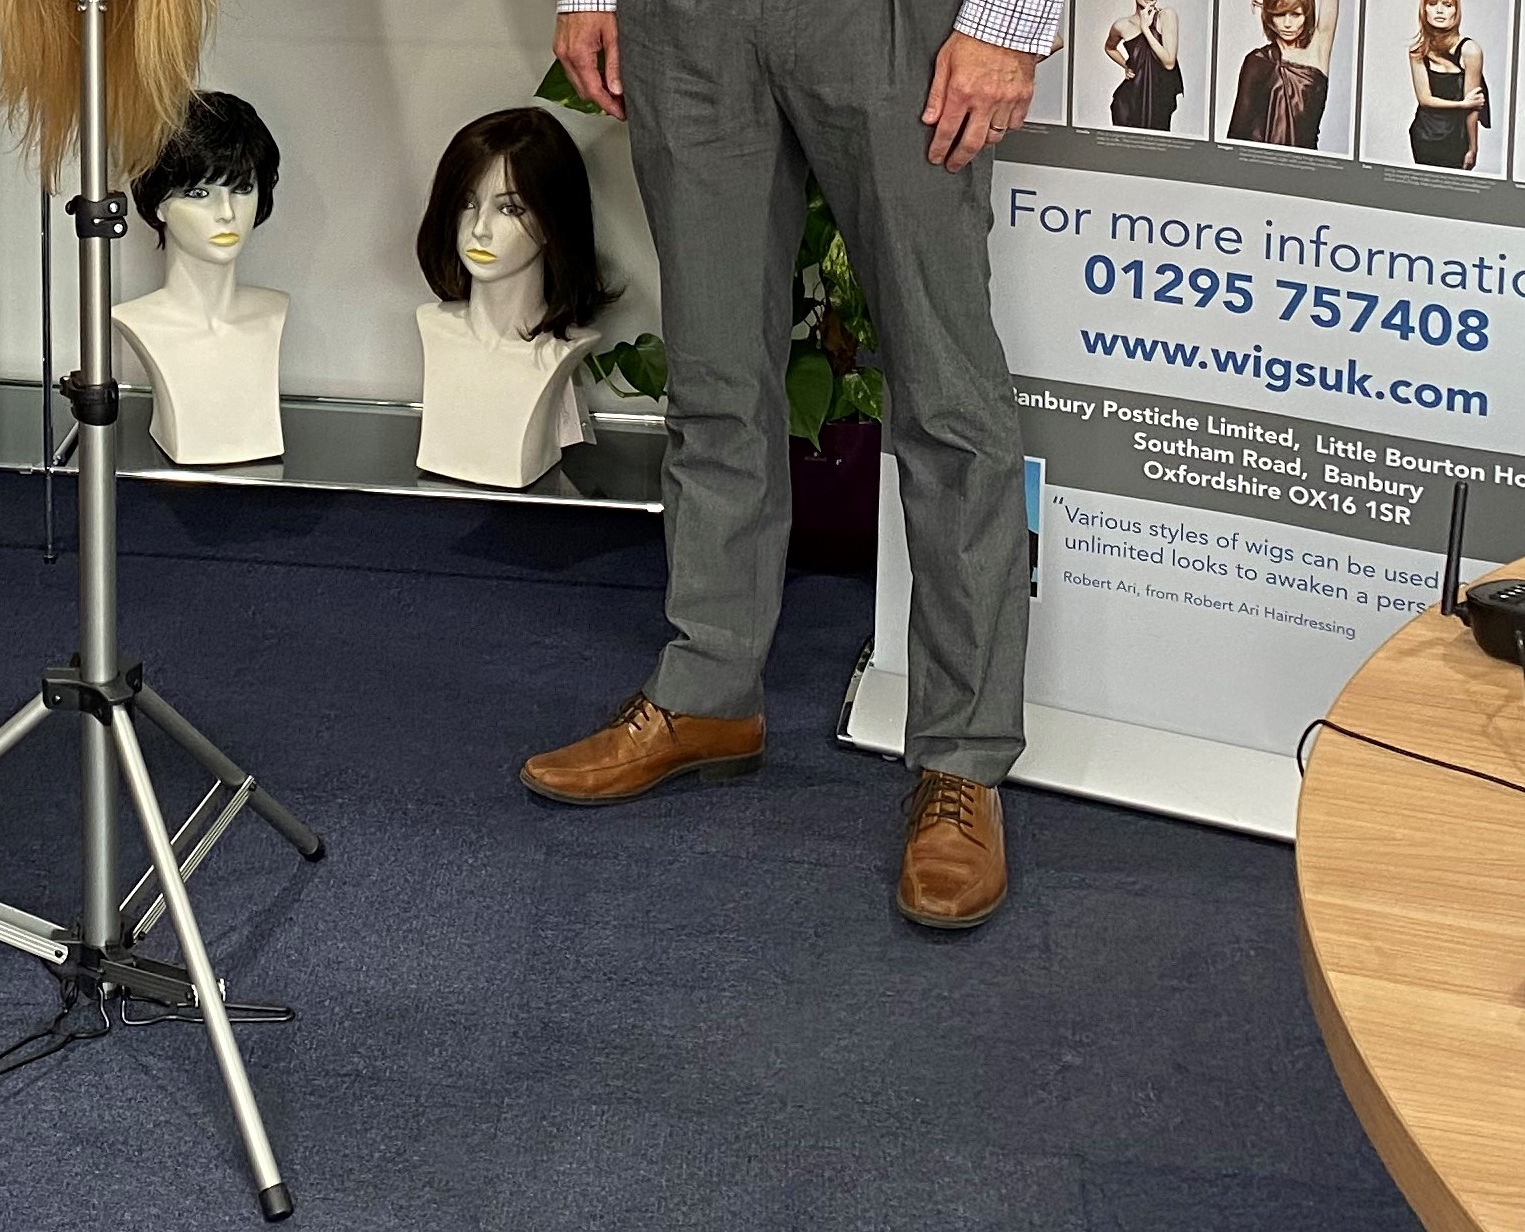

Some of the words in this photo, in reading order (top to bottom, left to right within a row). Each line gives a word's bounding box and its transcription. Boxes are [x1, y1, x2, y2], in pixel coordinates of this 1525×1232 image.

[1010, 188, 1092, 235] For
[1111, 212, 1243, 255] more
[1084, 254, 1254, 314] 01295
[1276, 279, 1489, 352] 757408
[1080, 329, 1489, 417] www.wigsuk.com
[1103, 400, 1200, 431] Postiche
[1207, 415, 1301, 452] Limited,
[1316, 434, 1377, 464] Little
[1385, 448, 1485, 482] Bourton
[1134, 431, 1234, 465] Southam
[1242, 450, 1308, 480] Road,
[1324, 464, 1424, 503] Banbury
[1143, 460, 1281, 500] Oxfordshire
[1289, 486, 1357, 515] OX16
[1365, 500, 1411, 526] 1SR
[1065, 535, 1164, 564] unlimited
[1172, 549, 1228, 576] looks
[1235, 563, 1258, 581] to
[1265, 572, 1348, 600] awaken
[1356, 590, 1368, 604] a
[1149, 523, 1209, 546] styles
[1216, 532, 1239, 550] of
[1245, 539, 1294, 563] wigs
[1302, 551, 1339, 571] can
[1347, 555, 1375, 578] be
[1384, 568, 1439, 590] used
[1064, 571, 1111, 591] Robert
[1116, 580, 1140, 597] Ari,
[1146, 584, 1179, 602] from
[1184, 592, 1234, 612] Robert
[1238, 603, 1259, 616] Ari
[1264, 606, 1356, 640] Hairdressing
